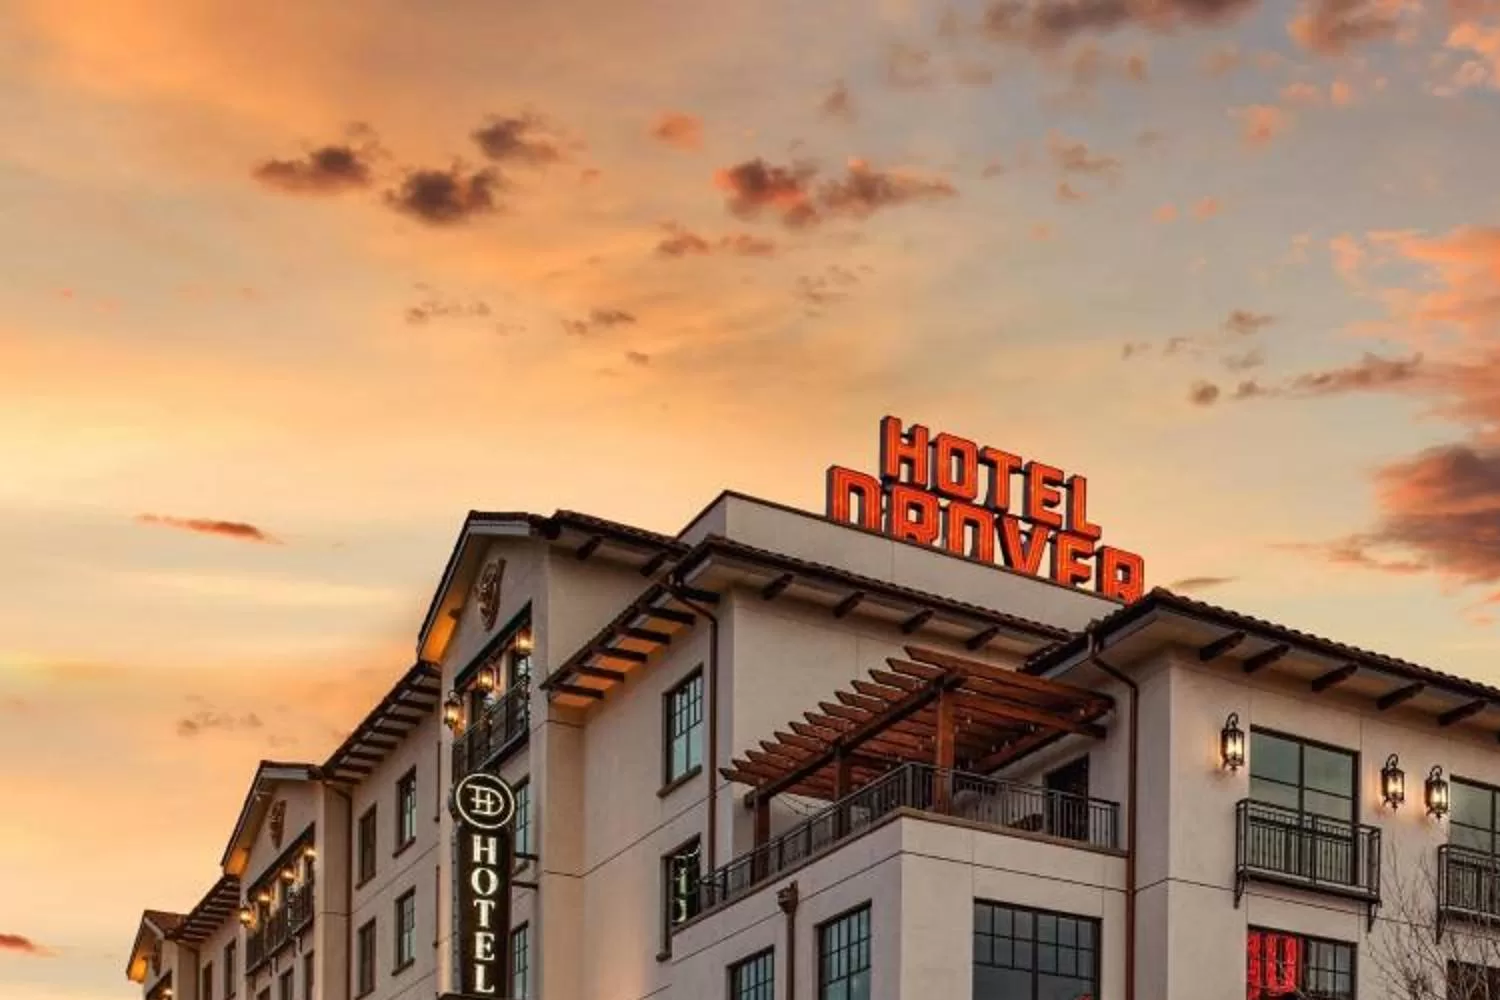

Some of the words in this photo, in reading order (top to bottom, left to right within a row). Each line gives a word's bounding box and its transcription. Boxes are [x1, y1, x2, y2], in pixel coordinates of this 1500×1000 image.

[827, 465, 1145, 604] DROVER
[880, 416, 1101, 539] HOTEL
[470, 833, 500, 994] HOTEL
